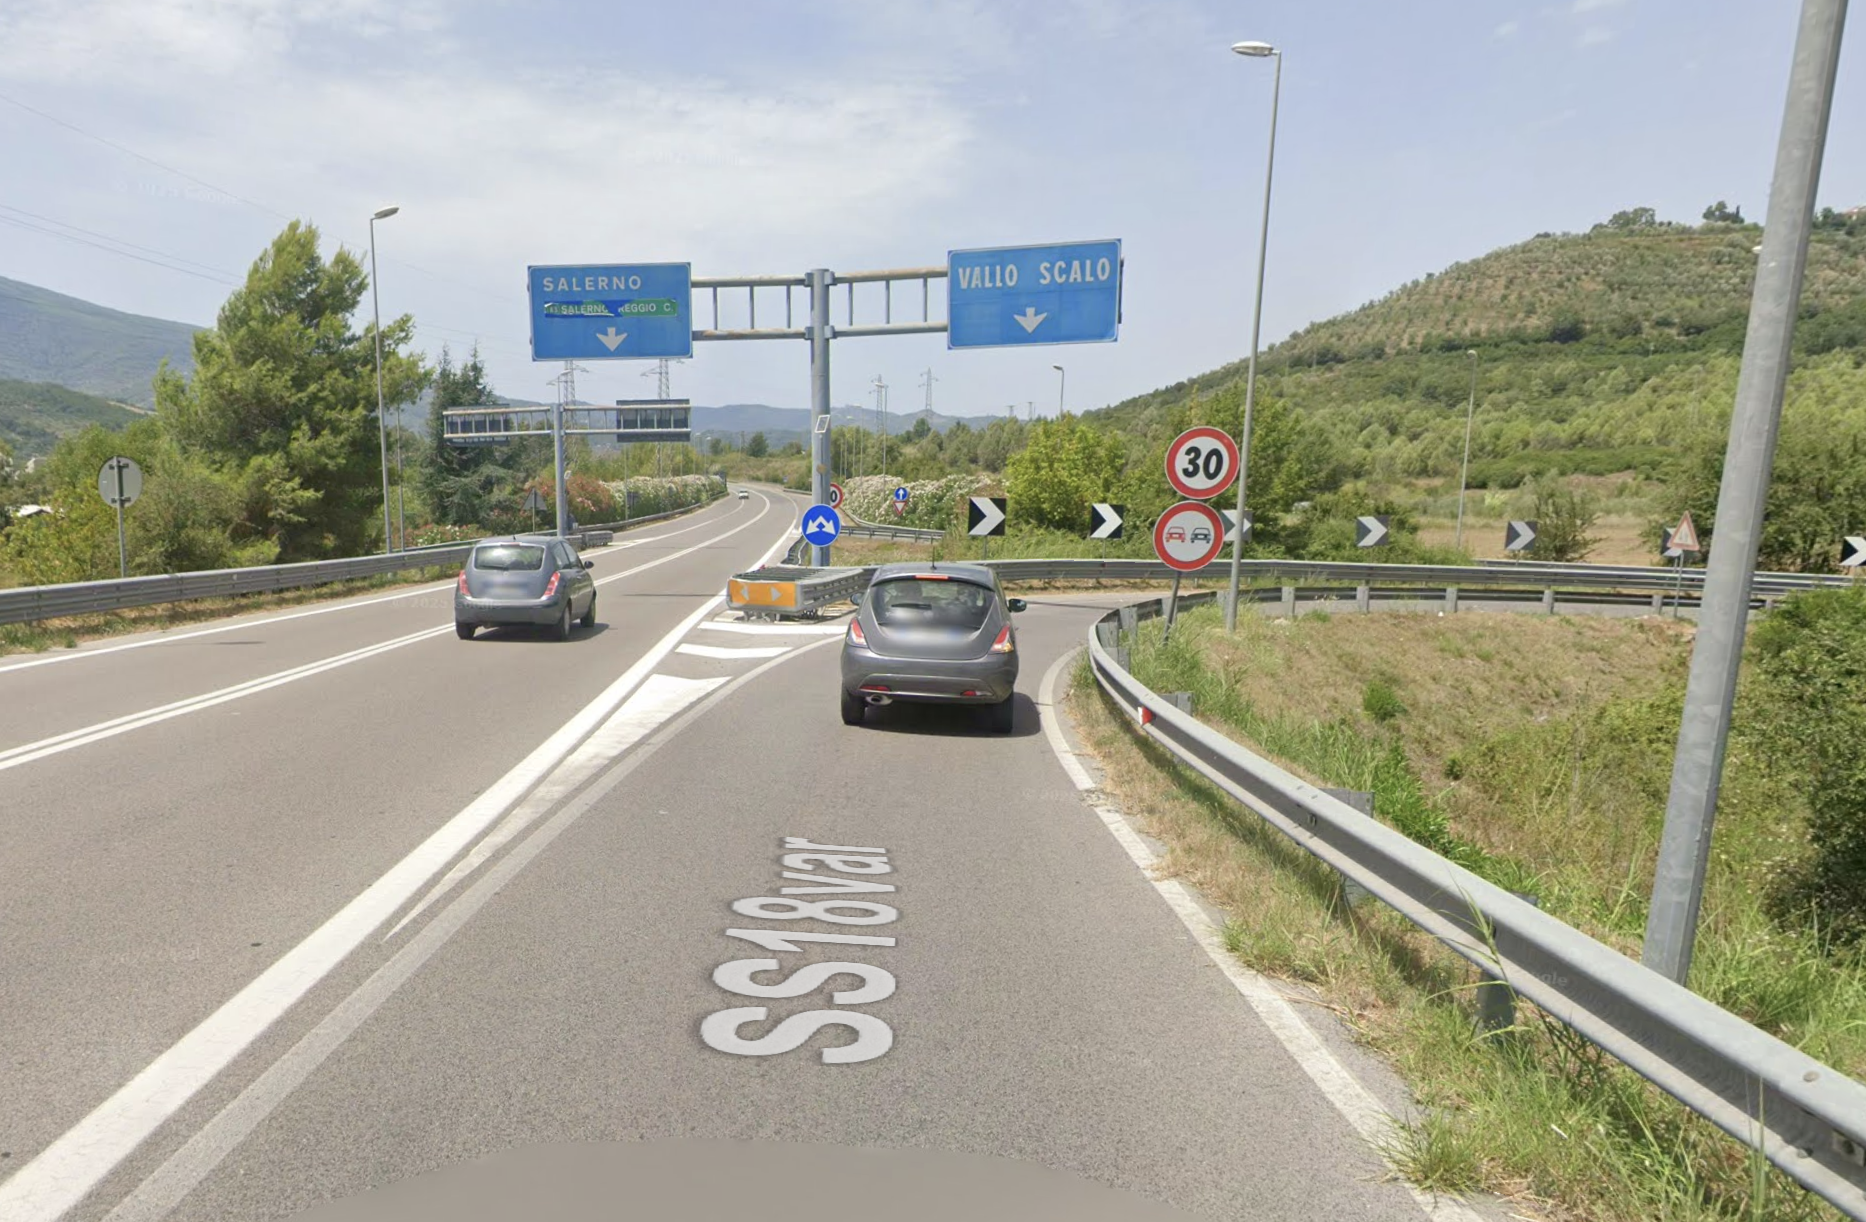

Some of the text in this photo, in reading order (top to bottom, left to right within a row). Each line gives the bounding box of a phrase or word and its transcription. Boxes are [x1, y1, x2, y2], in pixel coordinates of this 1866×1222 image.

[543, 275, 641, 291] SALERNO
[958, 257, 1110, 289] VALLO SCALO
[1182, 446, 1224, 480] 30
